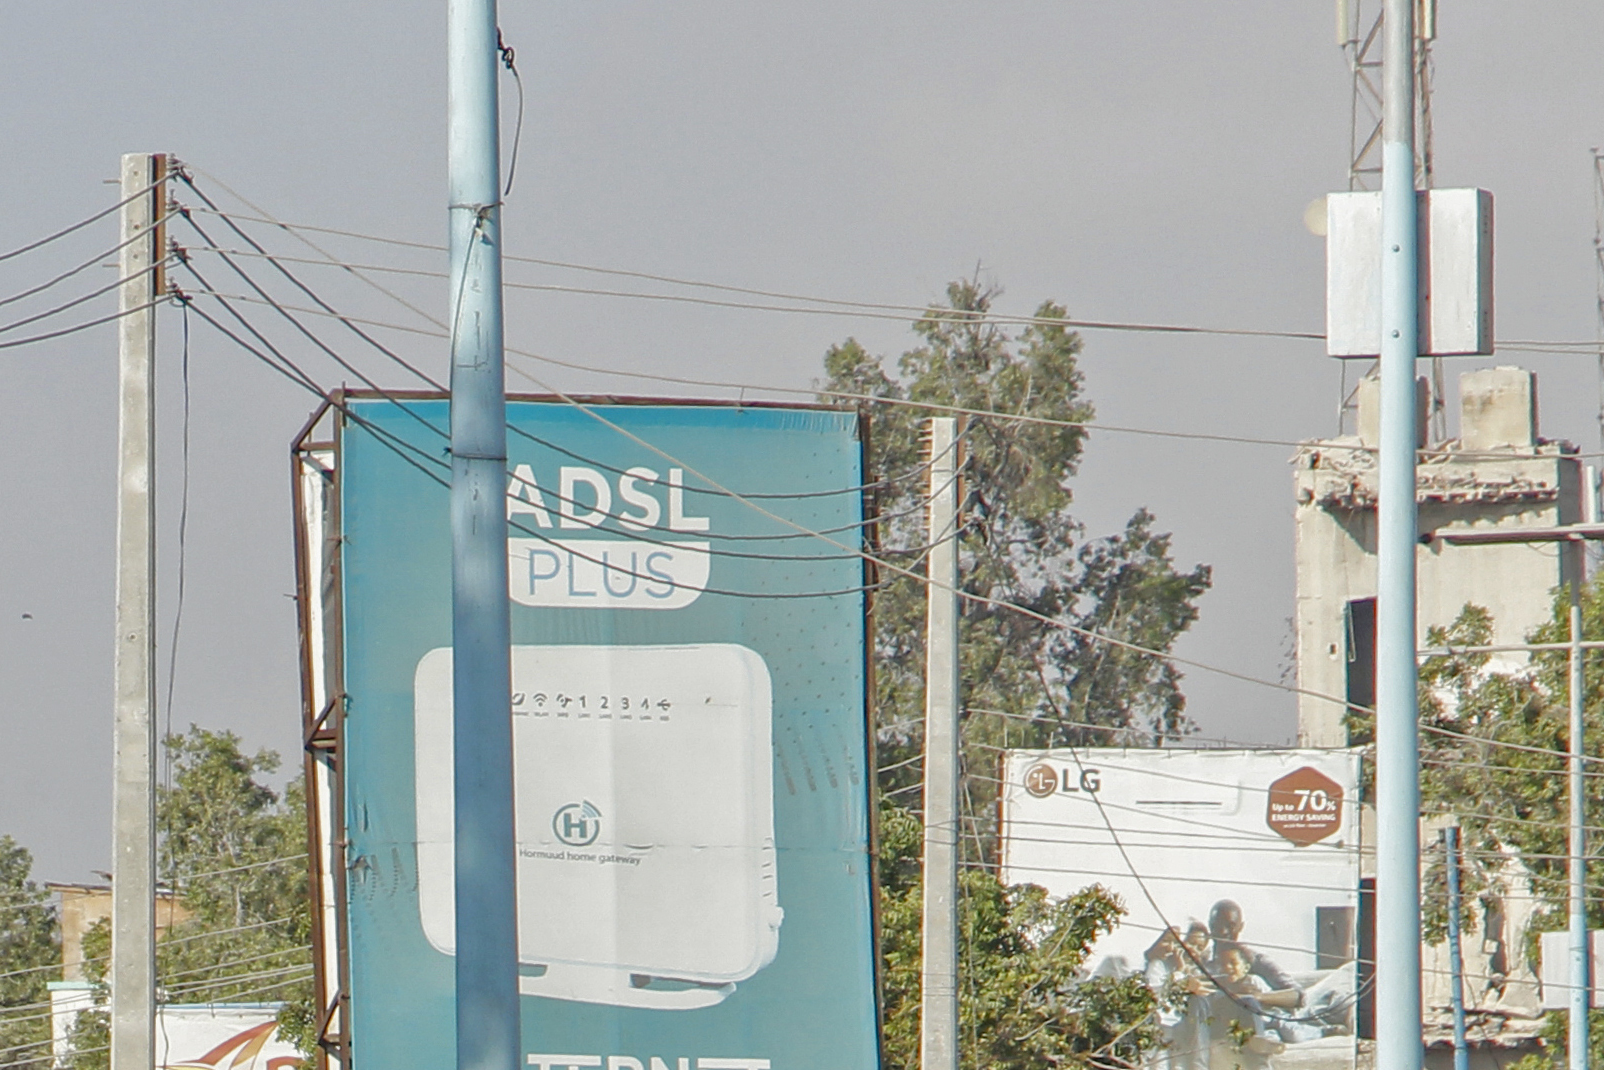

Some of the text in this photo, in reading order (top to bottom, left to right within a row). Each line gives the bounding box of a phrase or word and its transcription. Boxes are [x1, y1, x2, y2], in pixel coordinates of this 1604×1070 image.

[507, 463, 710, 532] ADSL
[529, 548, 676, 599] PLUS
[1062, 768, 1101, 793] LG
[1294, 789, 1336, 811] 70%
[519, 849, 641, 866] Hormuud home gateway
